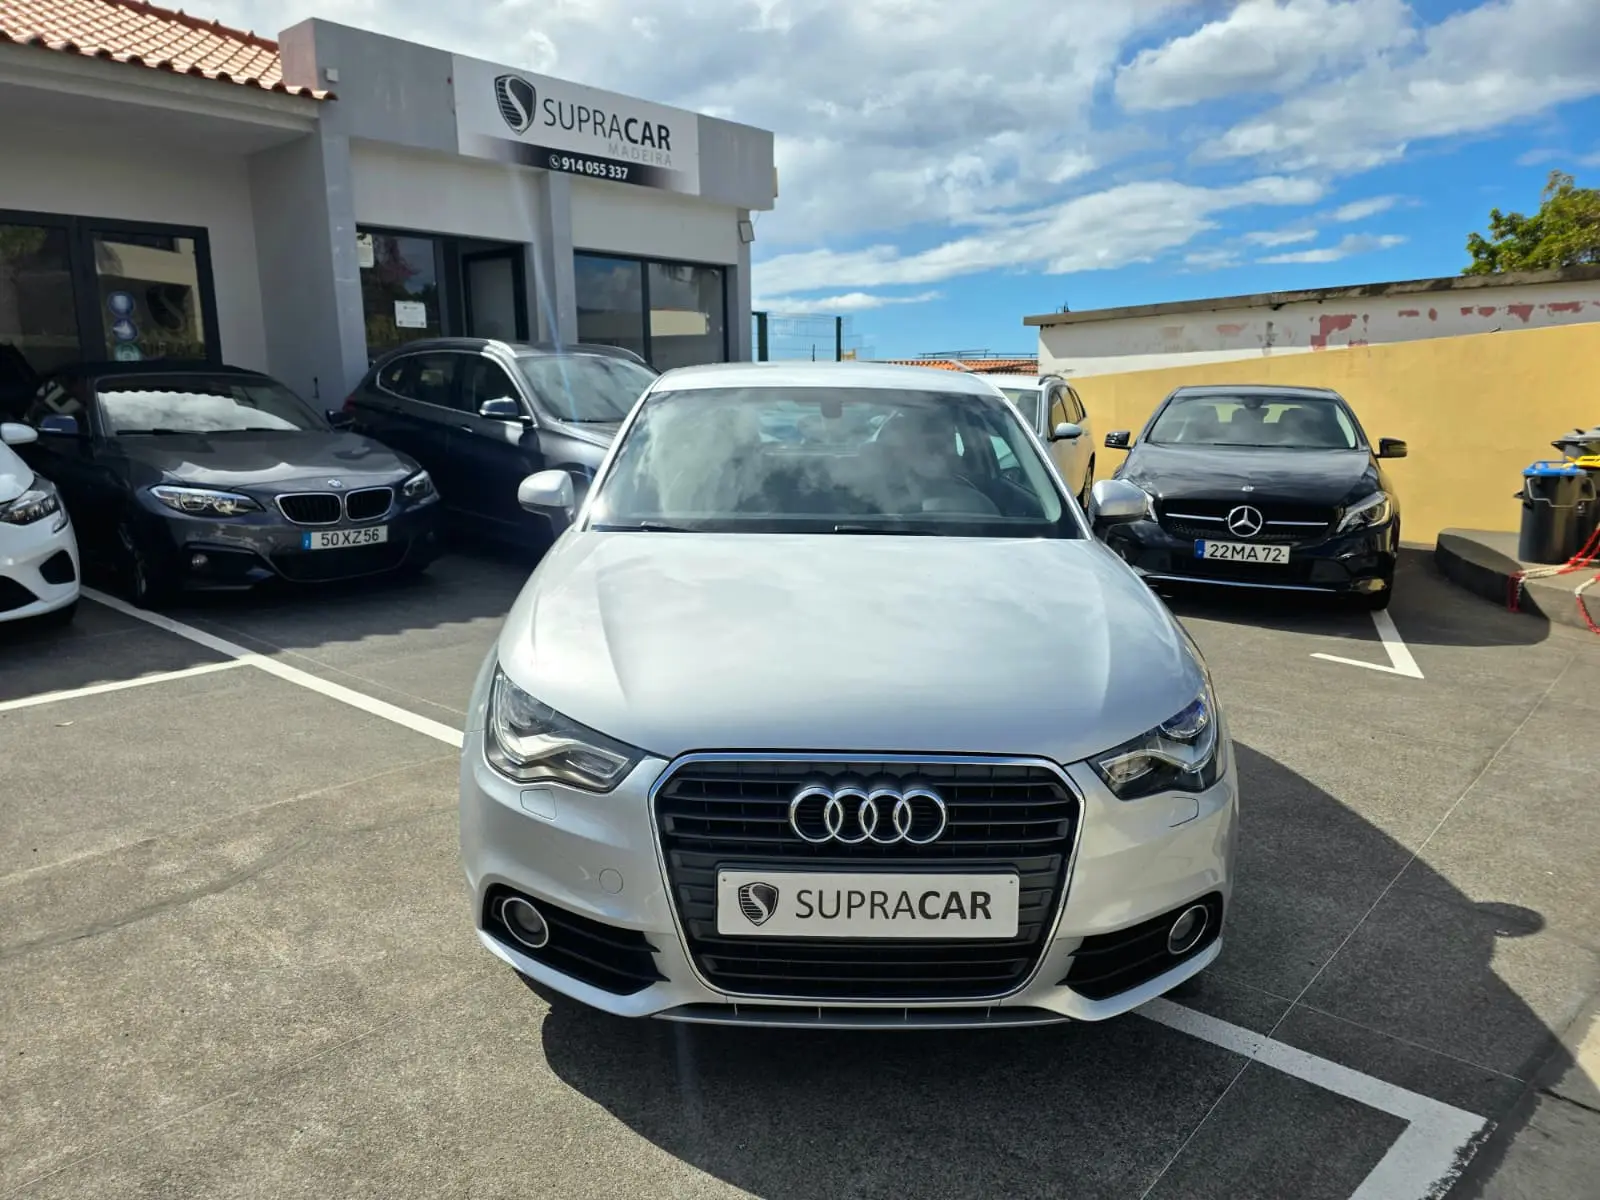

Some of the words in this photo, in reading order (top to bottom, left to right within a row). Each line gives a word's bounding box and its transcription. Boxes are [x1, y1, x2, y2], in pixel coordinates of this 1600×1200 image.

[543, 98, 671, 151] SUPRACAR
[562, 157, 584, 172] 914
[585, 161, 607, 176] 055
[608, 165, 628, 179] 337
[608, 143, 672, 167] MADEIRA
[795, 889, 992, 920] SUPRACAR
